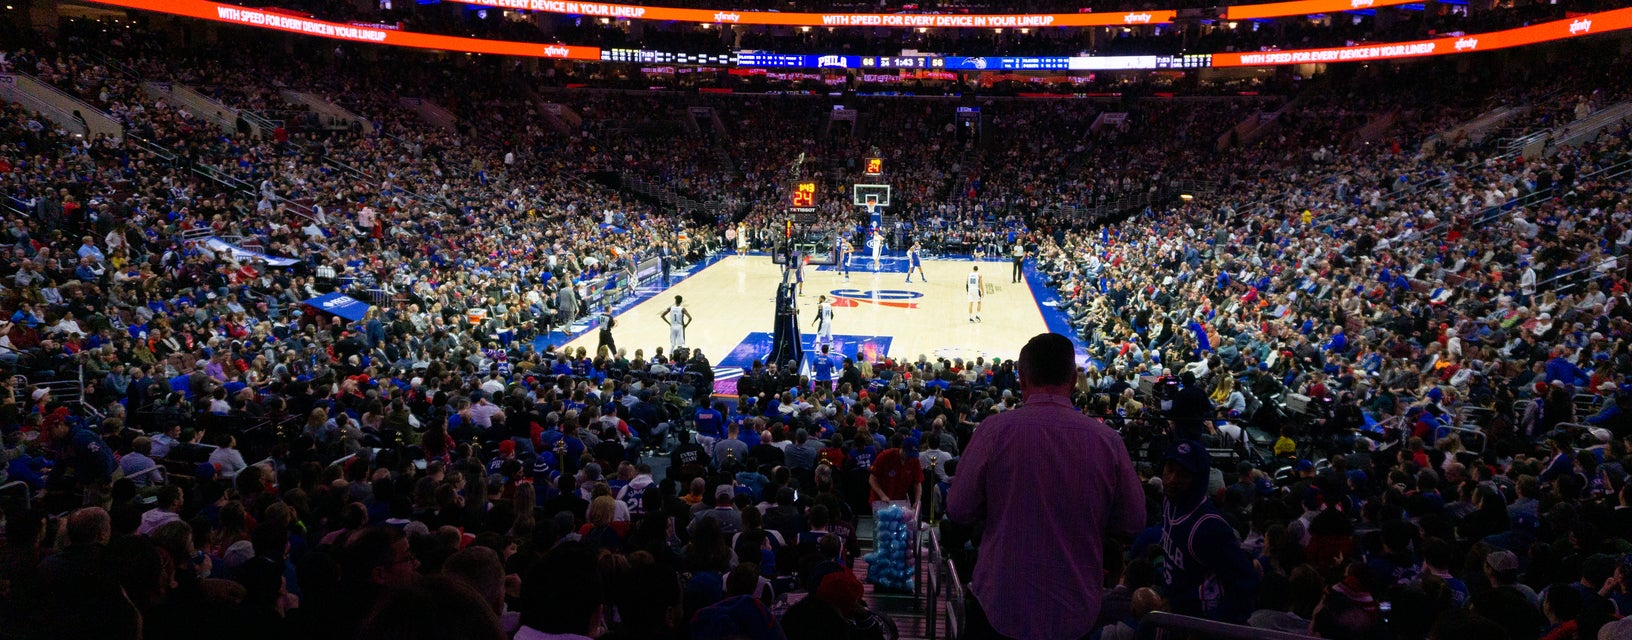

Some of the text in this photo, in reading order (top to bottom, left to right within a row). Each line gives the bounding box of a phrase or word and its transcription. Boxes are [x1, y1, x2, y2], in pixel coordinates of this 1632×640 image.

[528, 0, 559, 12] DEVICE
[562, 3, 573, 13] IN
[580, 4, 607, 15] YOUR
[609, 6, 645, 17] LINEUP
[714, 11, 740, 22] xfinity
[822, 15, 1054, 26] WITH SPEED FOR EVERY DEVICE IN YOUR LINEUP
[1124, 12, 1152, 24] xfinity
[217, 6, 387, 41] WITH SPEED FOR EVERY DEVICE IN YOUR LINEUP
[1569, 19, 1592, 34] xfinity
[1454, 37, 1478, 50] xfinity
[544, 45, 569, 57] xfinity
[1240, 43, 1435, 64] WITH SPEED FOR EVERY DEVICE IN YOUR LINEUP
[817, 55, 848, 68] PHILA
[863, 58, 874, 66] 66
[894, 58, 914, 67] 1:43
[867, 163, 880, 173] 24
[793, 191, 813, 206] 24
[680, 450, 698, 459] EVENT
